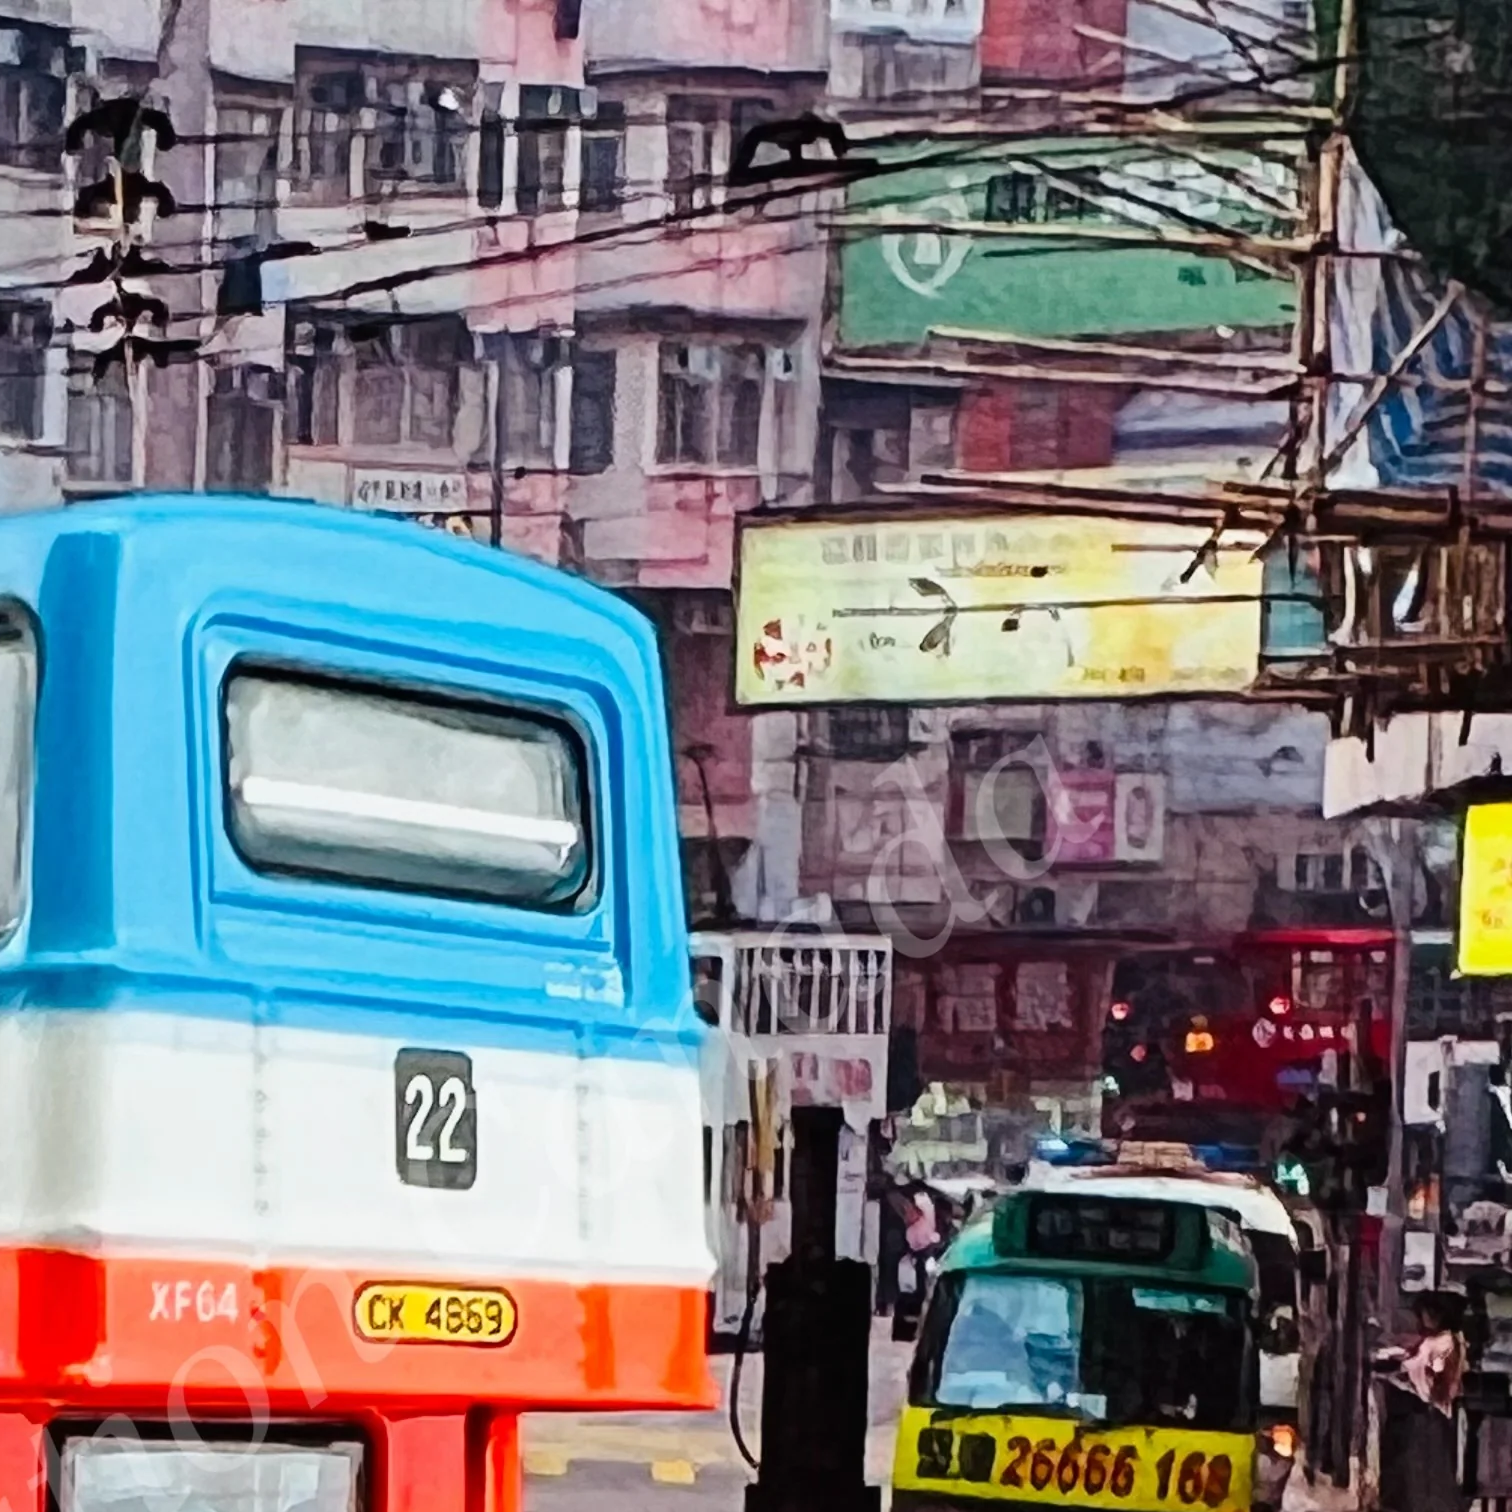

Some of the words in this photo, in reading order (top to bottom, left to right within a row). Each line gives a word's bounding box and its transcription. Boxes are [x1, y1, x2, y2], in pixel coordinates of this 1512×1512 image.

[405, 1073, 469, 1164] 22
[149, 1280, 240, 1322] XF64
[368, 1293, 407, 1331] CK
[425, 1295, 503, 1336] 4869
